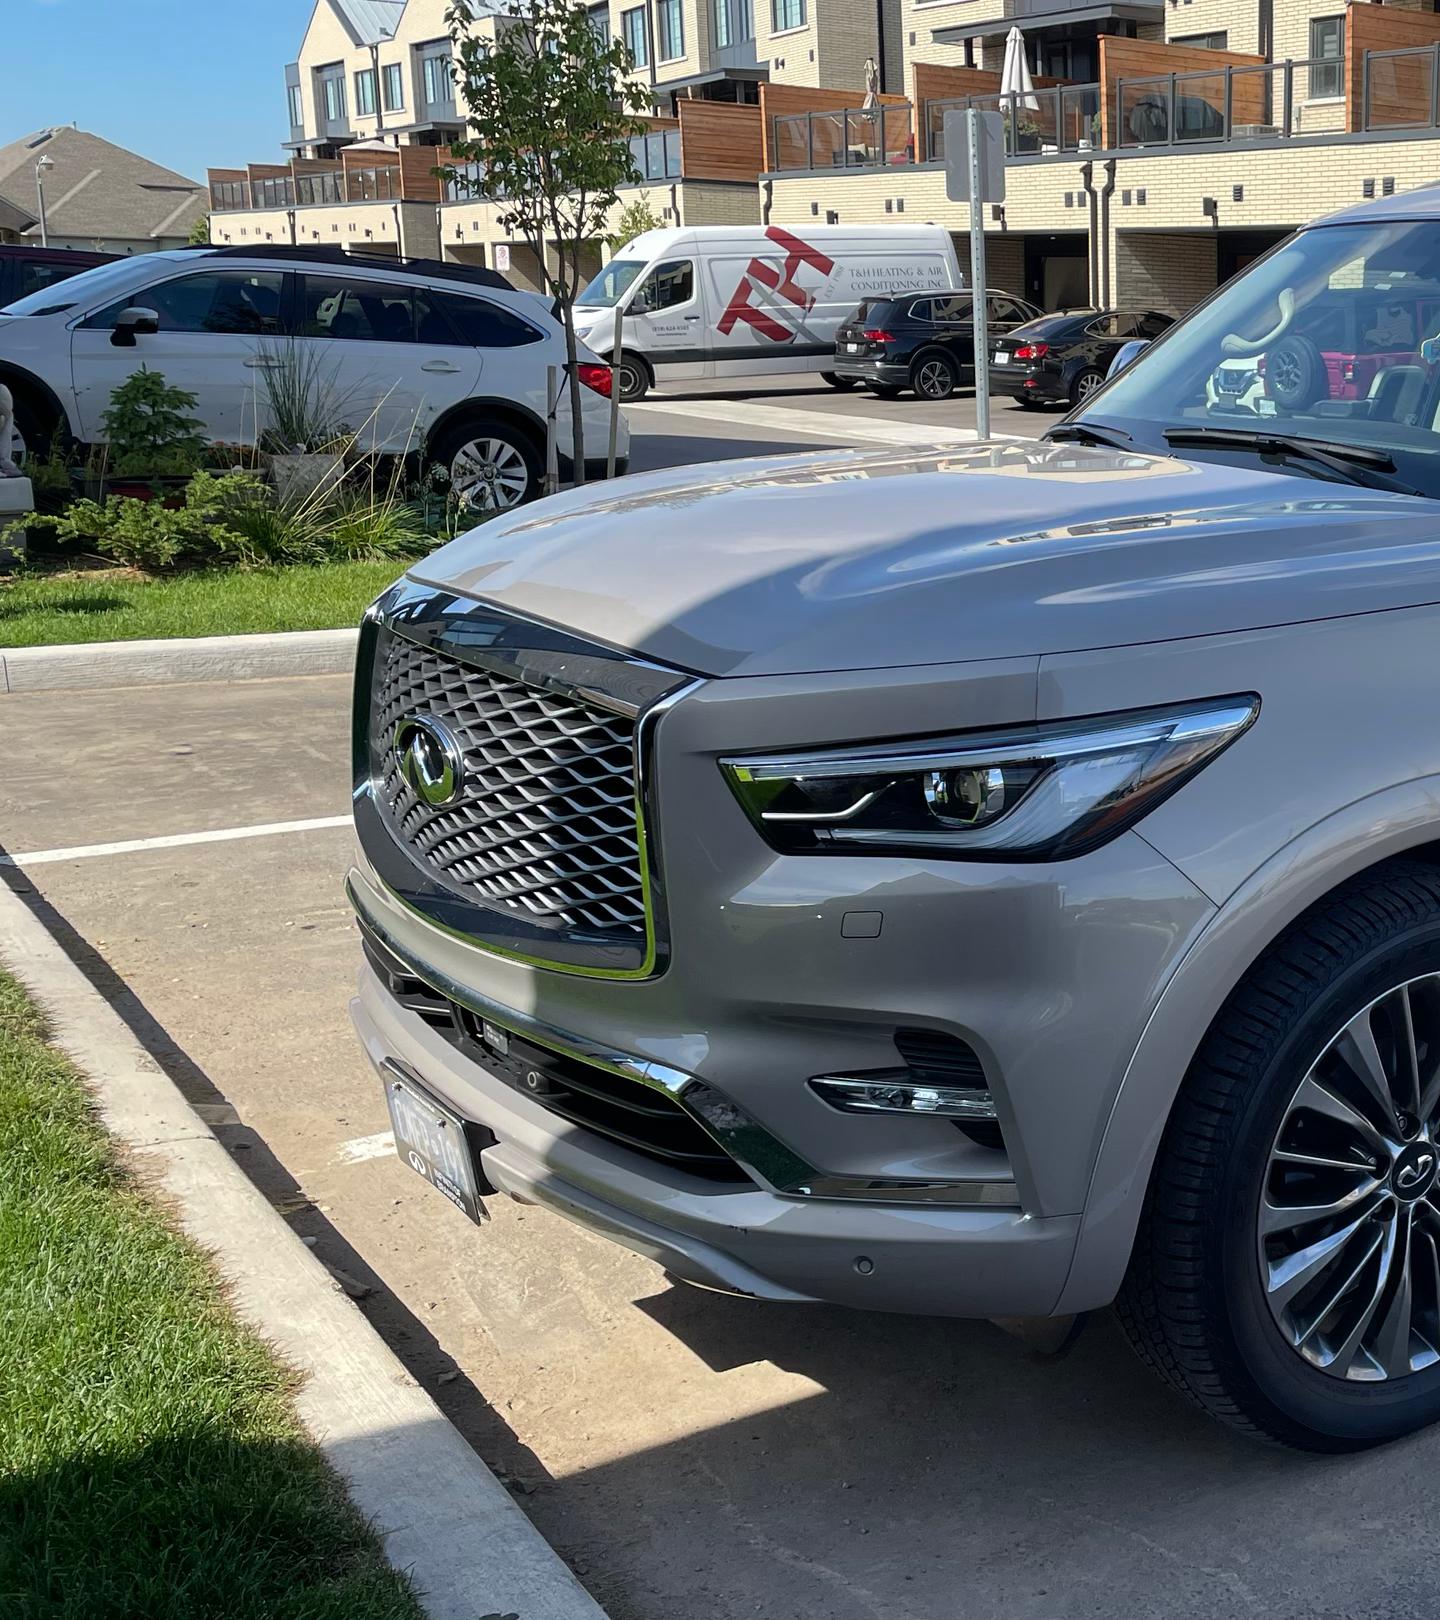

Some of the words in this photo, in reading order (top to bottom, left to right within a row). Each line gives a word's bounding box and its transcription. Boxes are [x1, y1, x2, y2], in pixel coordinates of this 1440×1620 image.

[872, 266, 914, 277] HEATING
[927, 266, 943, 276] AIR
[850, 280, 924, 291] CONDITIONING
